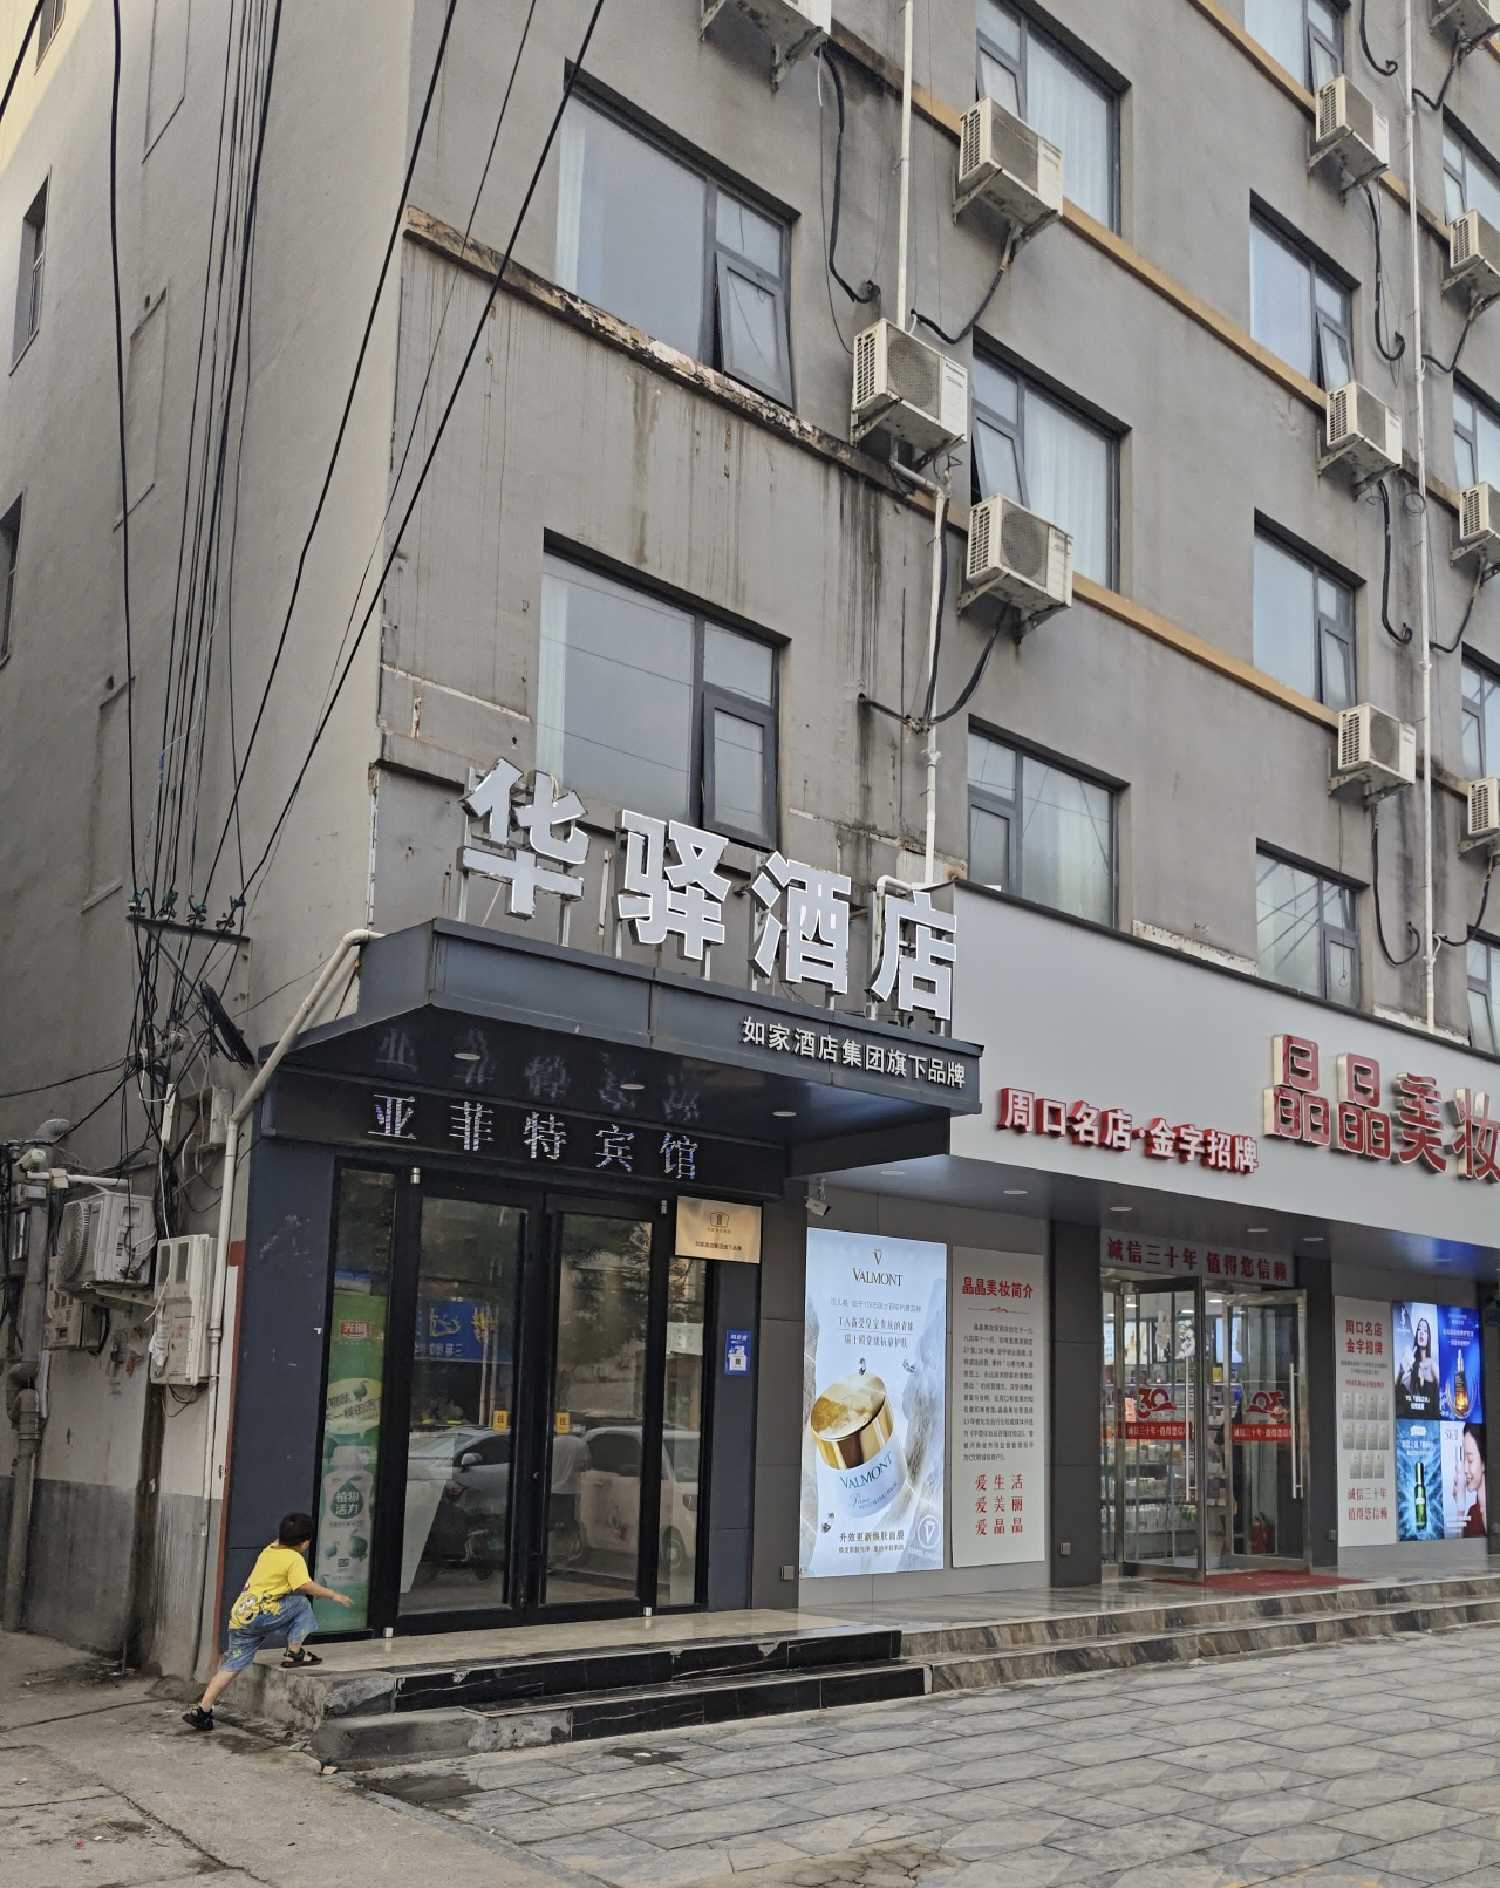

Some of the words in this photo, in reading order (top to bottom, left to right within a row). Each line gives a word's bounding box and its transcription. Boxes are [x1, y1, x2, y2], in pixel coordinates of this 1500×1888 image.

[459, 757, 957, 1021] 华驿酒店
[741, 1015, 966, 1090] 如家酒店集团旗下品牌
[1263, 1034, 1500, 1183] 晶晶美妆
[366, 1094, 699, 1180] 亚菲特宾馆
[1107, 1236, 1197, 1269] 诚信三十年
[1206, 1254, 1288, 1284] 值得您信赖
[852, 1267, 904, 1287] VALMONT
[961, 1275, 1033, 1301] 晶晶美妆简介
[1344, 1319, 1384, 1338] 周口名店
[1344, 1338, 1384, 1356] 金字招牌
[839, 1450, 893, 1491] VALMONT
[975, 1472, 1024, 1492] 爱生活
[975, 1495, 1024, 1514] 爱美丽
[1346, 1487, 1388, 1502] 诚信三十年
[975, 1518, 1024, 1537] 爱晶晶
